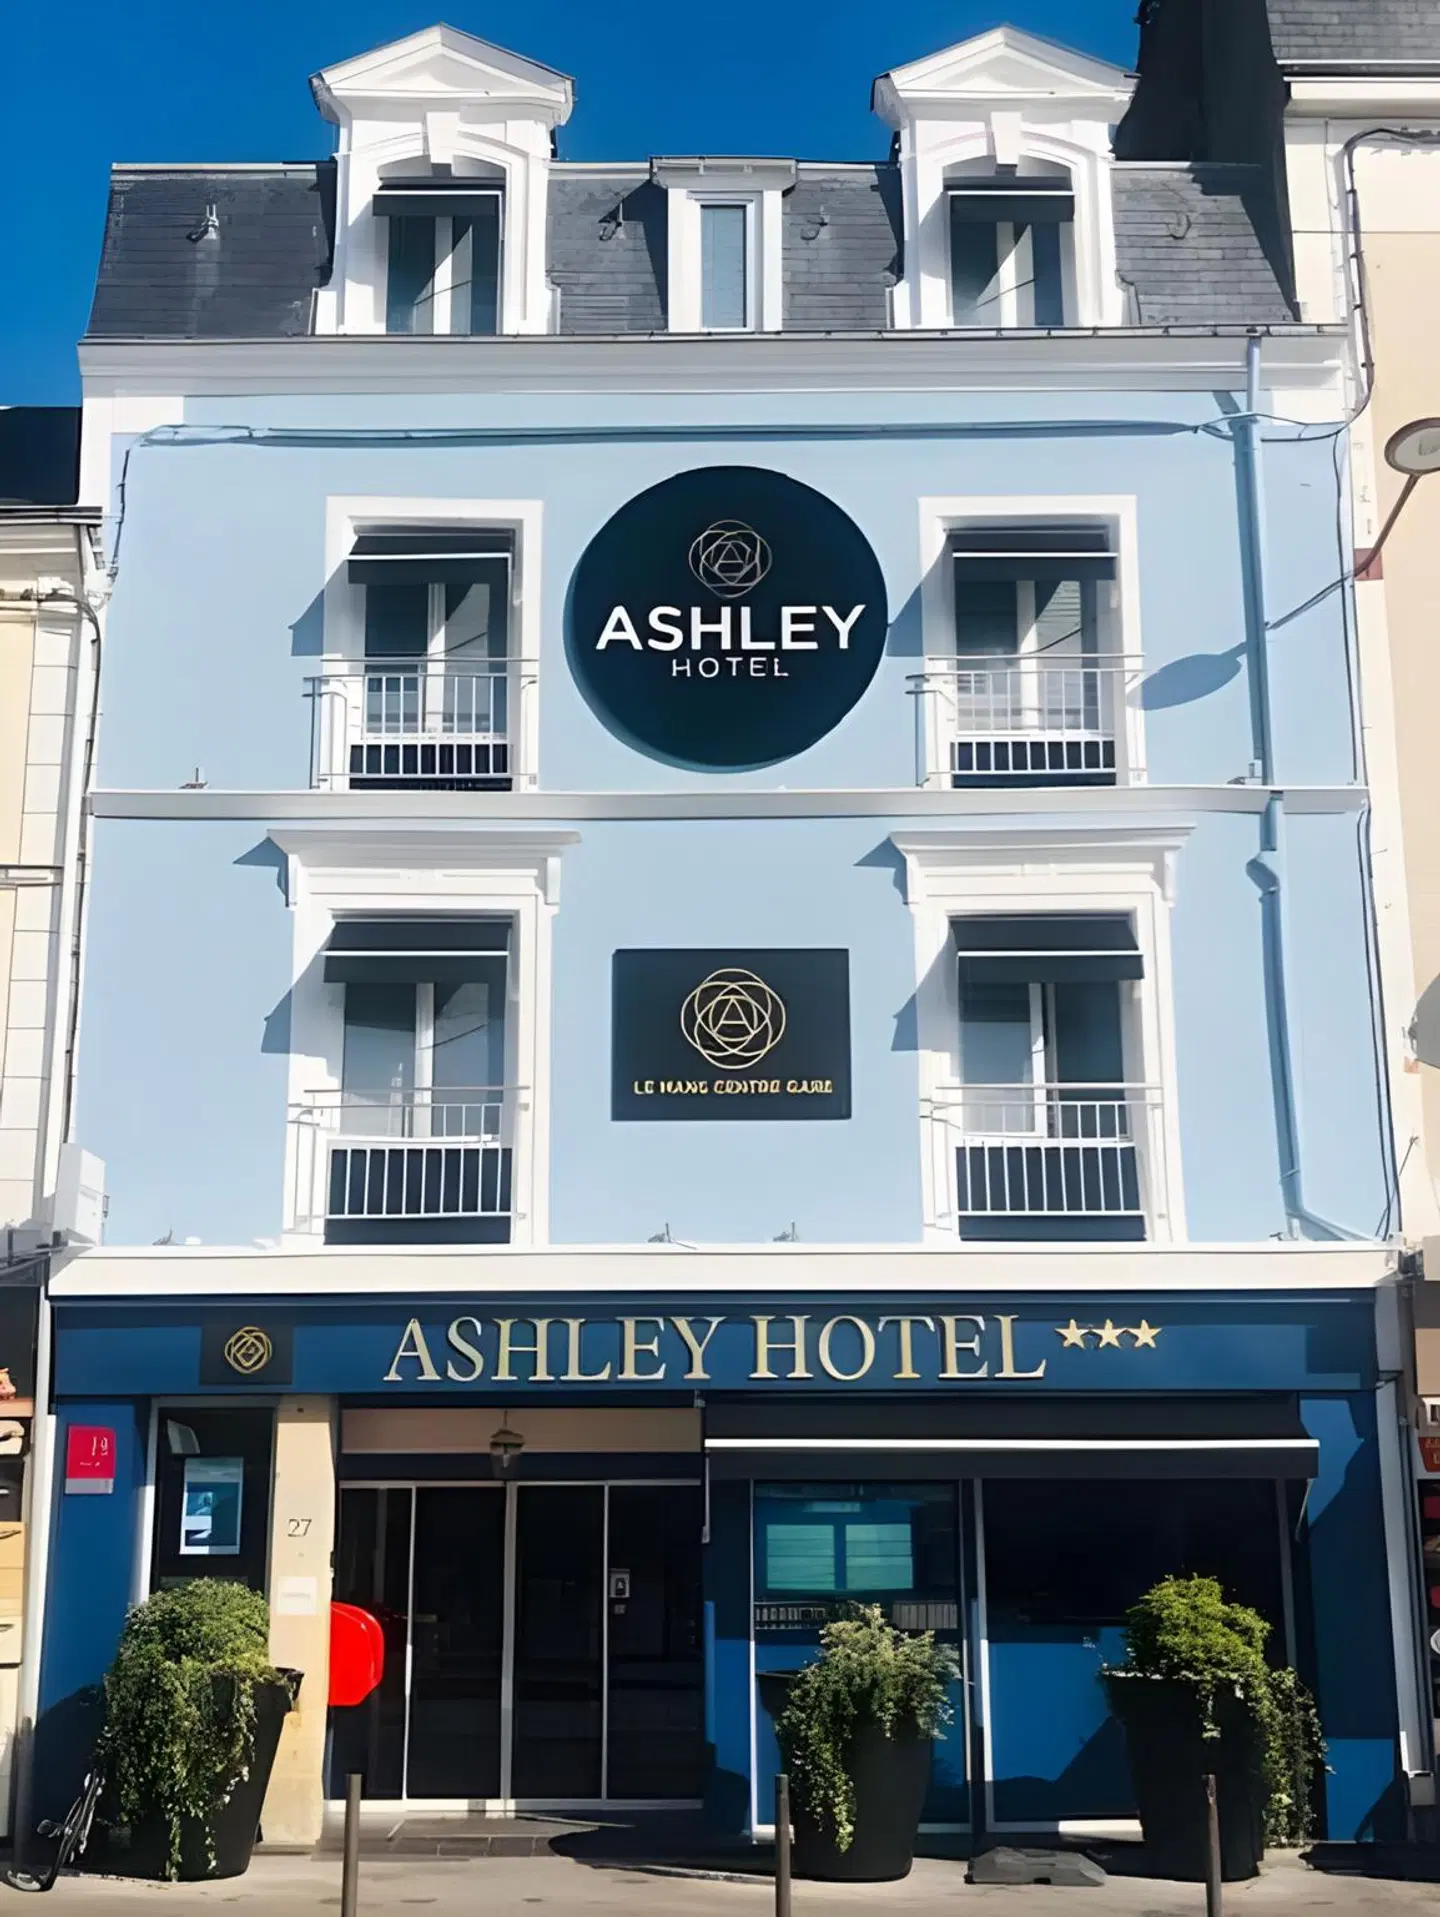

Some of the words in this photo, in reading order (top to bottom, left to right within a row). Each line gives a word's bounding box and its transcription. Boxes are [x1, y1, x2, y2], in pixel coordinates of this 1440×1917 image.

[596, 604, 866, 650] ASHLEY
[672, 657, 789, 678] HOTEL
[384, 1317, 725, 1382] ASHLEY
[749, 1315, 1046, 1381] HOTEL
[288, 1518, 312, 1537] 27
